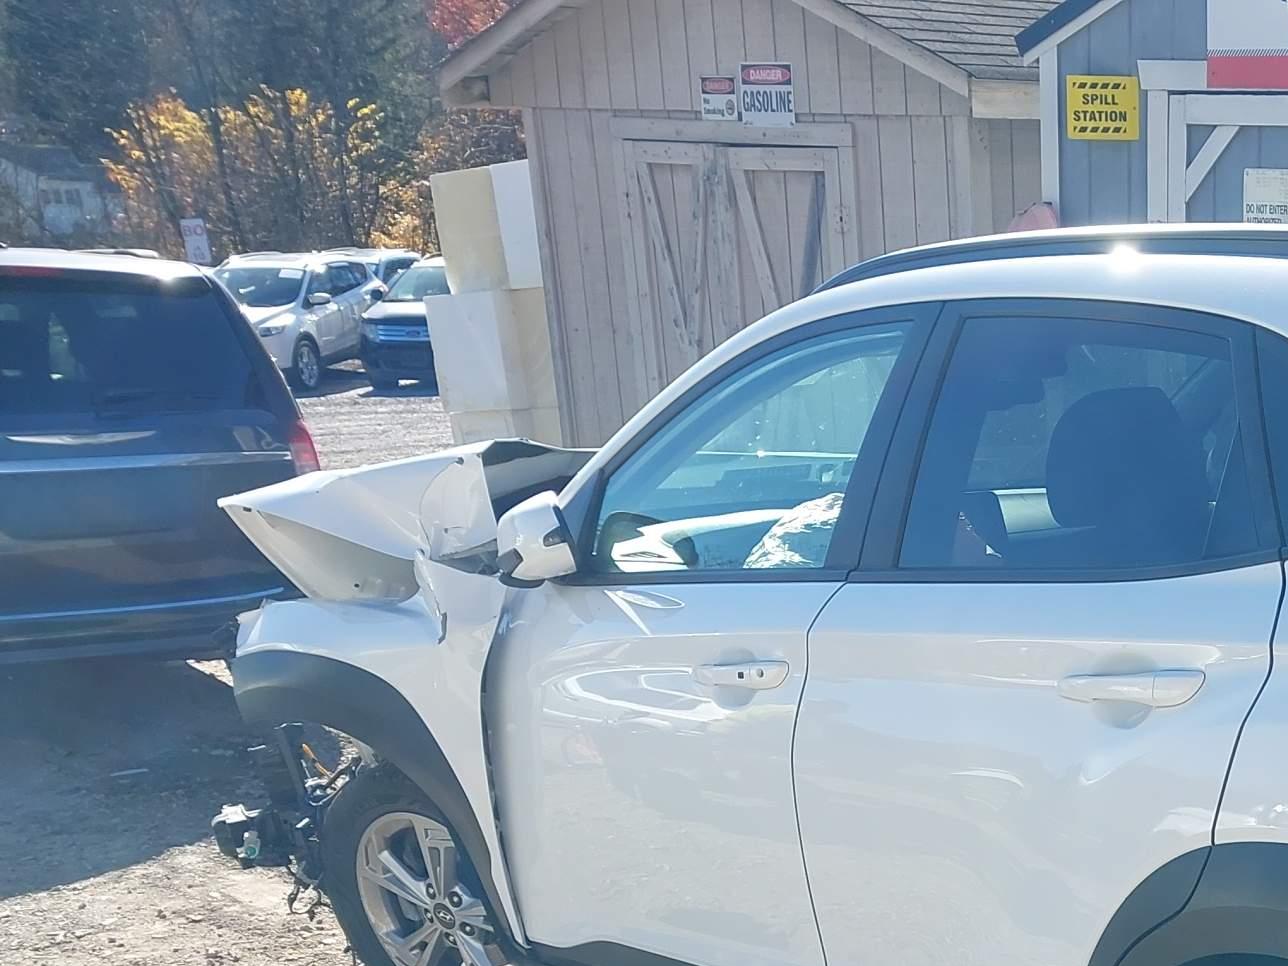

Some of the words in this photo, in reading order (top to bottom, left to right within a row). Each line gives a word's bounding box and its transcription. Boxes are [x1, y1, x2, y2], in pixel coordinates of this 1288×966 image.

[749, 69, 782, 80] DANGER
[742, 90, 793, 112] GASOLINE
[1082, 93, 1119, 105] SPILL
[1073, 110, 1127, 122] STATION
[1246, 203, 1255, 213] DO
[1256, 204, 1267, 215] NOT
[1268, 204, 1288, 216] ENTER
